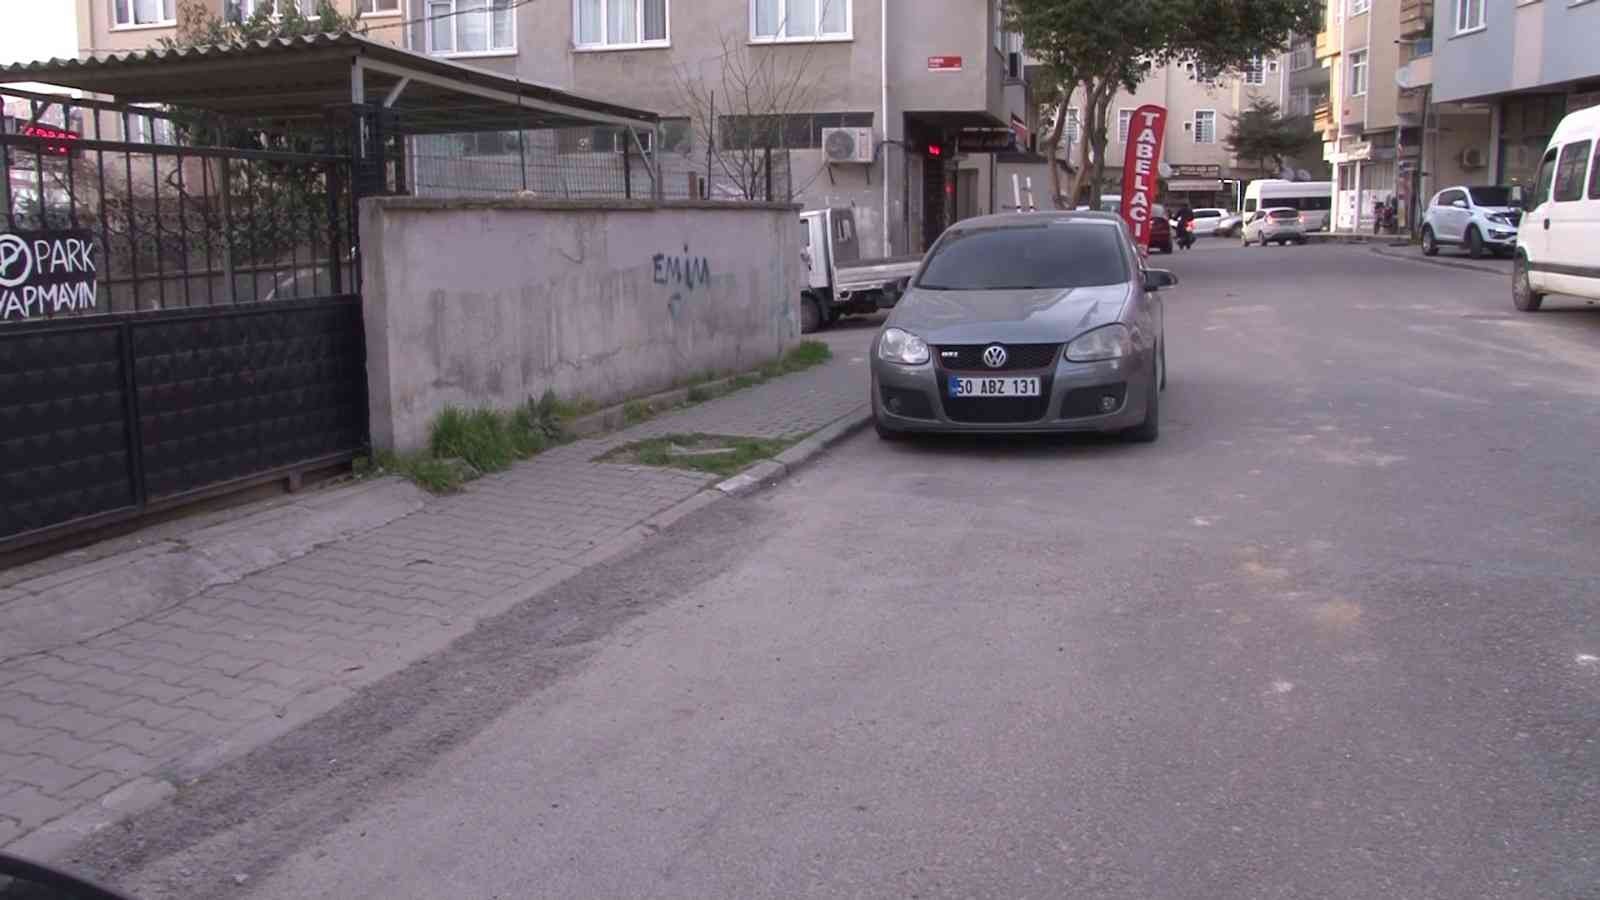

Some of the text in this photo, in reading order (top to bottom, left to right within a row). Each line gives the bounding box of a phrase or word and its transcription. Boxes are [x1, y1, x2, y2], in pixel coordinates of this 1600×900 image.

[1129, 111, 1160, 237] TABELACI
[34, 238, 96, 274] PARK
[958, 379, 973, 394] 50
[980, 379, 1005, 394] ABZ
[1013, 379, 1036, 394] 131
